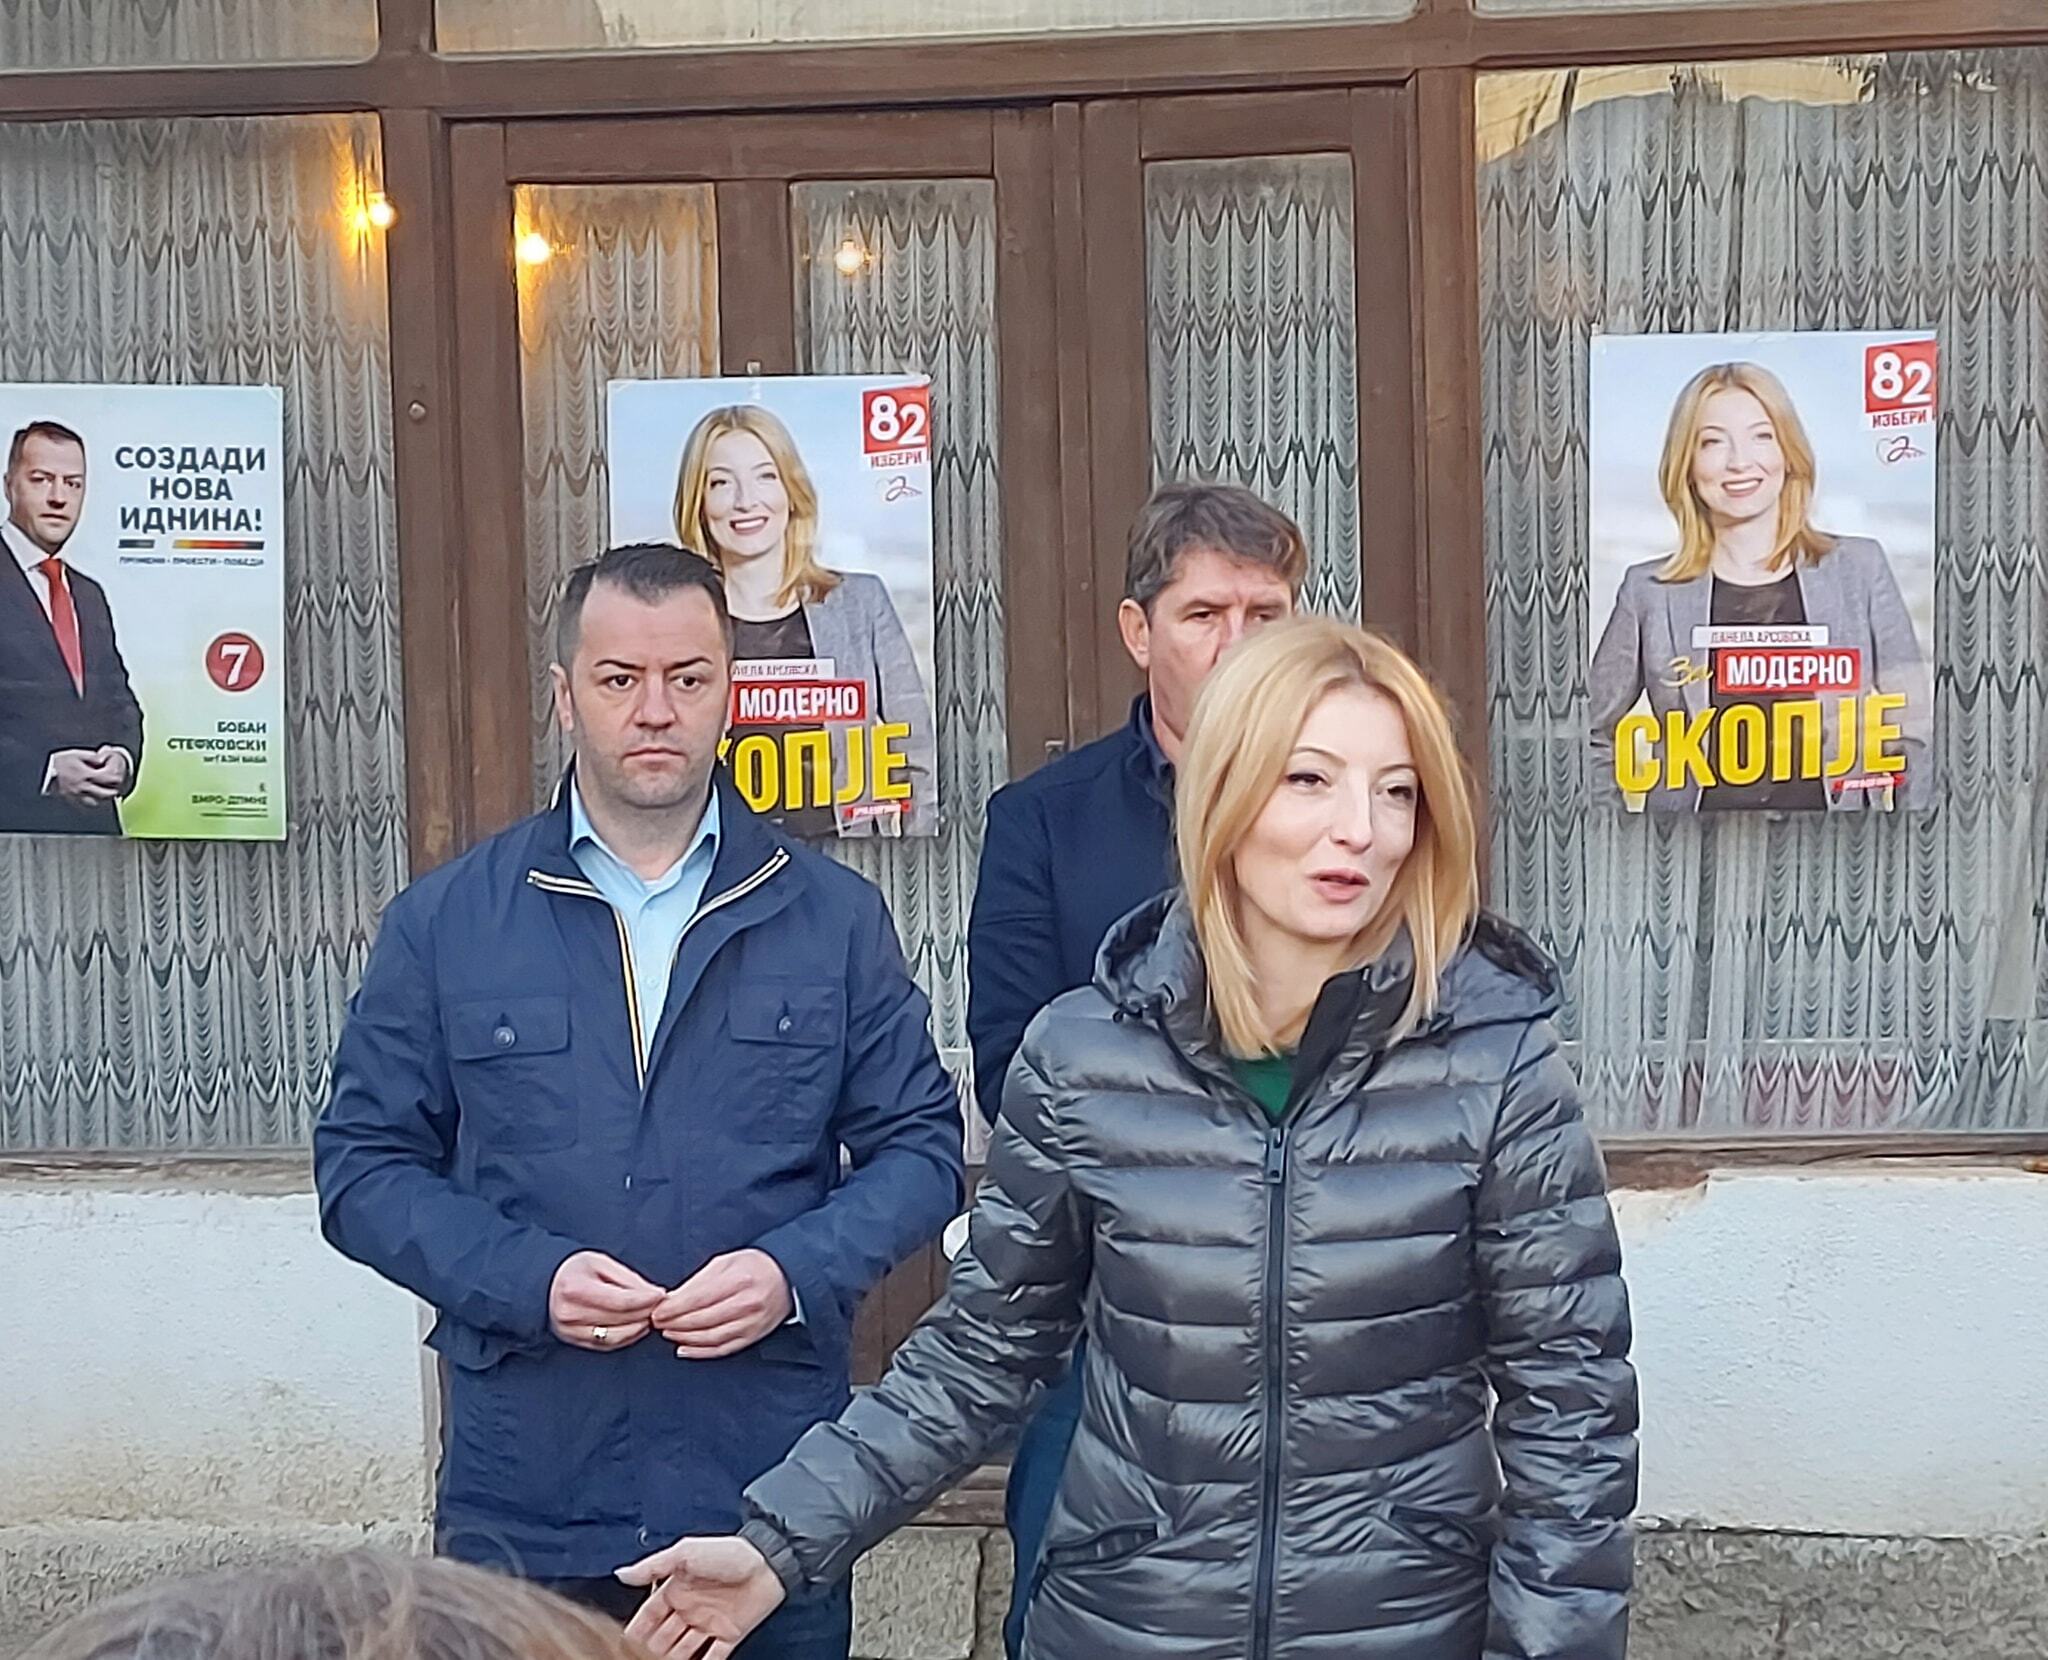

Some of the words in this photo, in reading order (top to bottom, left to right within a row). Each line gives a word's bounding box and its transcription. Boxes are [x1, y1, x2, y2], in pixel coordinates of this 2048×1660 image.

[1871, 351, 1932, 404] 82
[869, 395, 926, 445] 82
[1872, 410, 1927, 428] ИЗБЕРИ
[115, 447, 265, 474] СОЗДАДИ
[871, 451, 922, 468] ИЗБЕРИ
[150, 477, 233, 500] НОВА
[120, 506, 262, 534] ИДНИНА!
[220, 643, 250, 686] 7
[1727, 655, 1851, 688] МОДЕРНО
[739, 686, 859, 721] МОДЕРНО
[217, 721, 266, 734] БОБАН
[1615, 692, 1906, 793] СКОПЈЕ
[717, 722, 911, 813] ОПЈЕ
